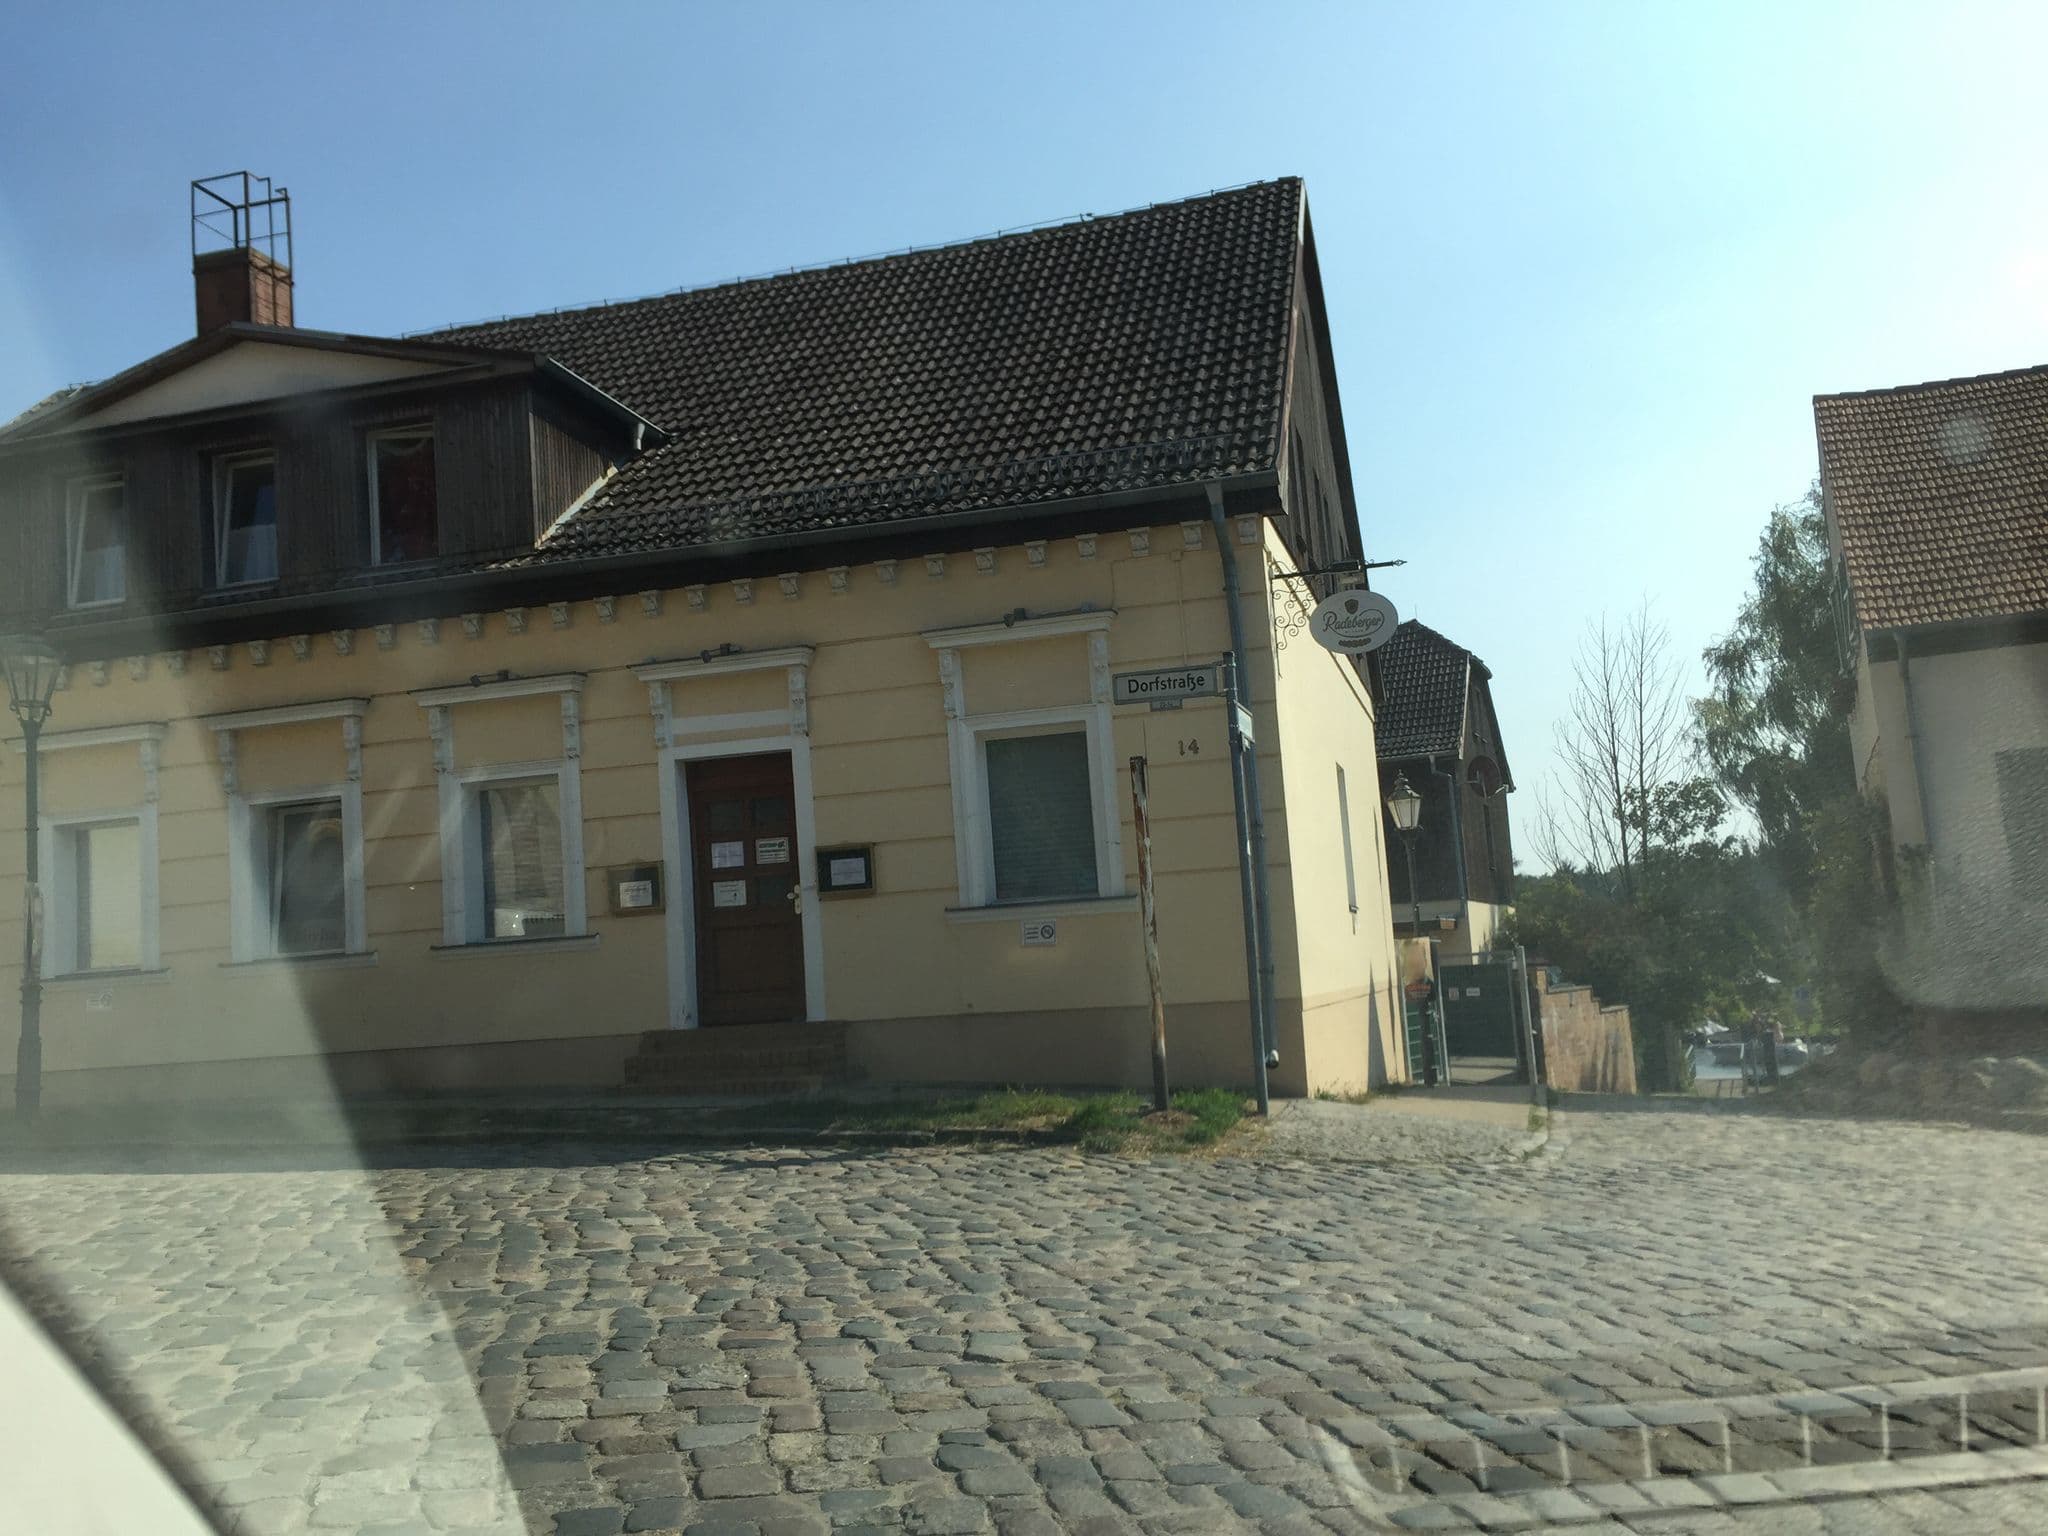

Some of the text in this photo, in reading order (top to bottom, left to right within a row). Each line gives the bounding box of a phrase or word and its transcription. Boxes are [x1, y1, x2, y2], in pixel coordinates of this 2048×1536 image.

[1322, 609, 1385, 635] Radeberger
[1127, 673, 1206, 694] Dorfstraße
[1178, 738, 1200, 757] 14
